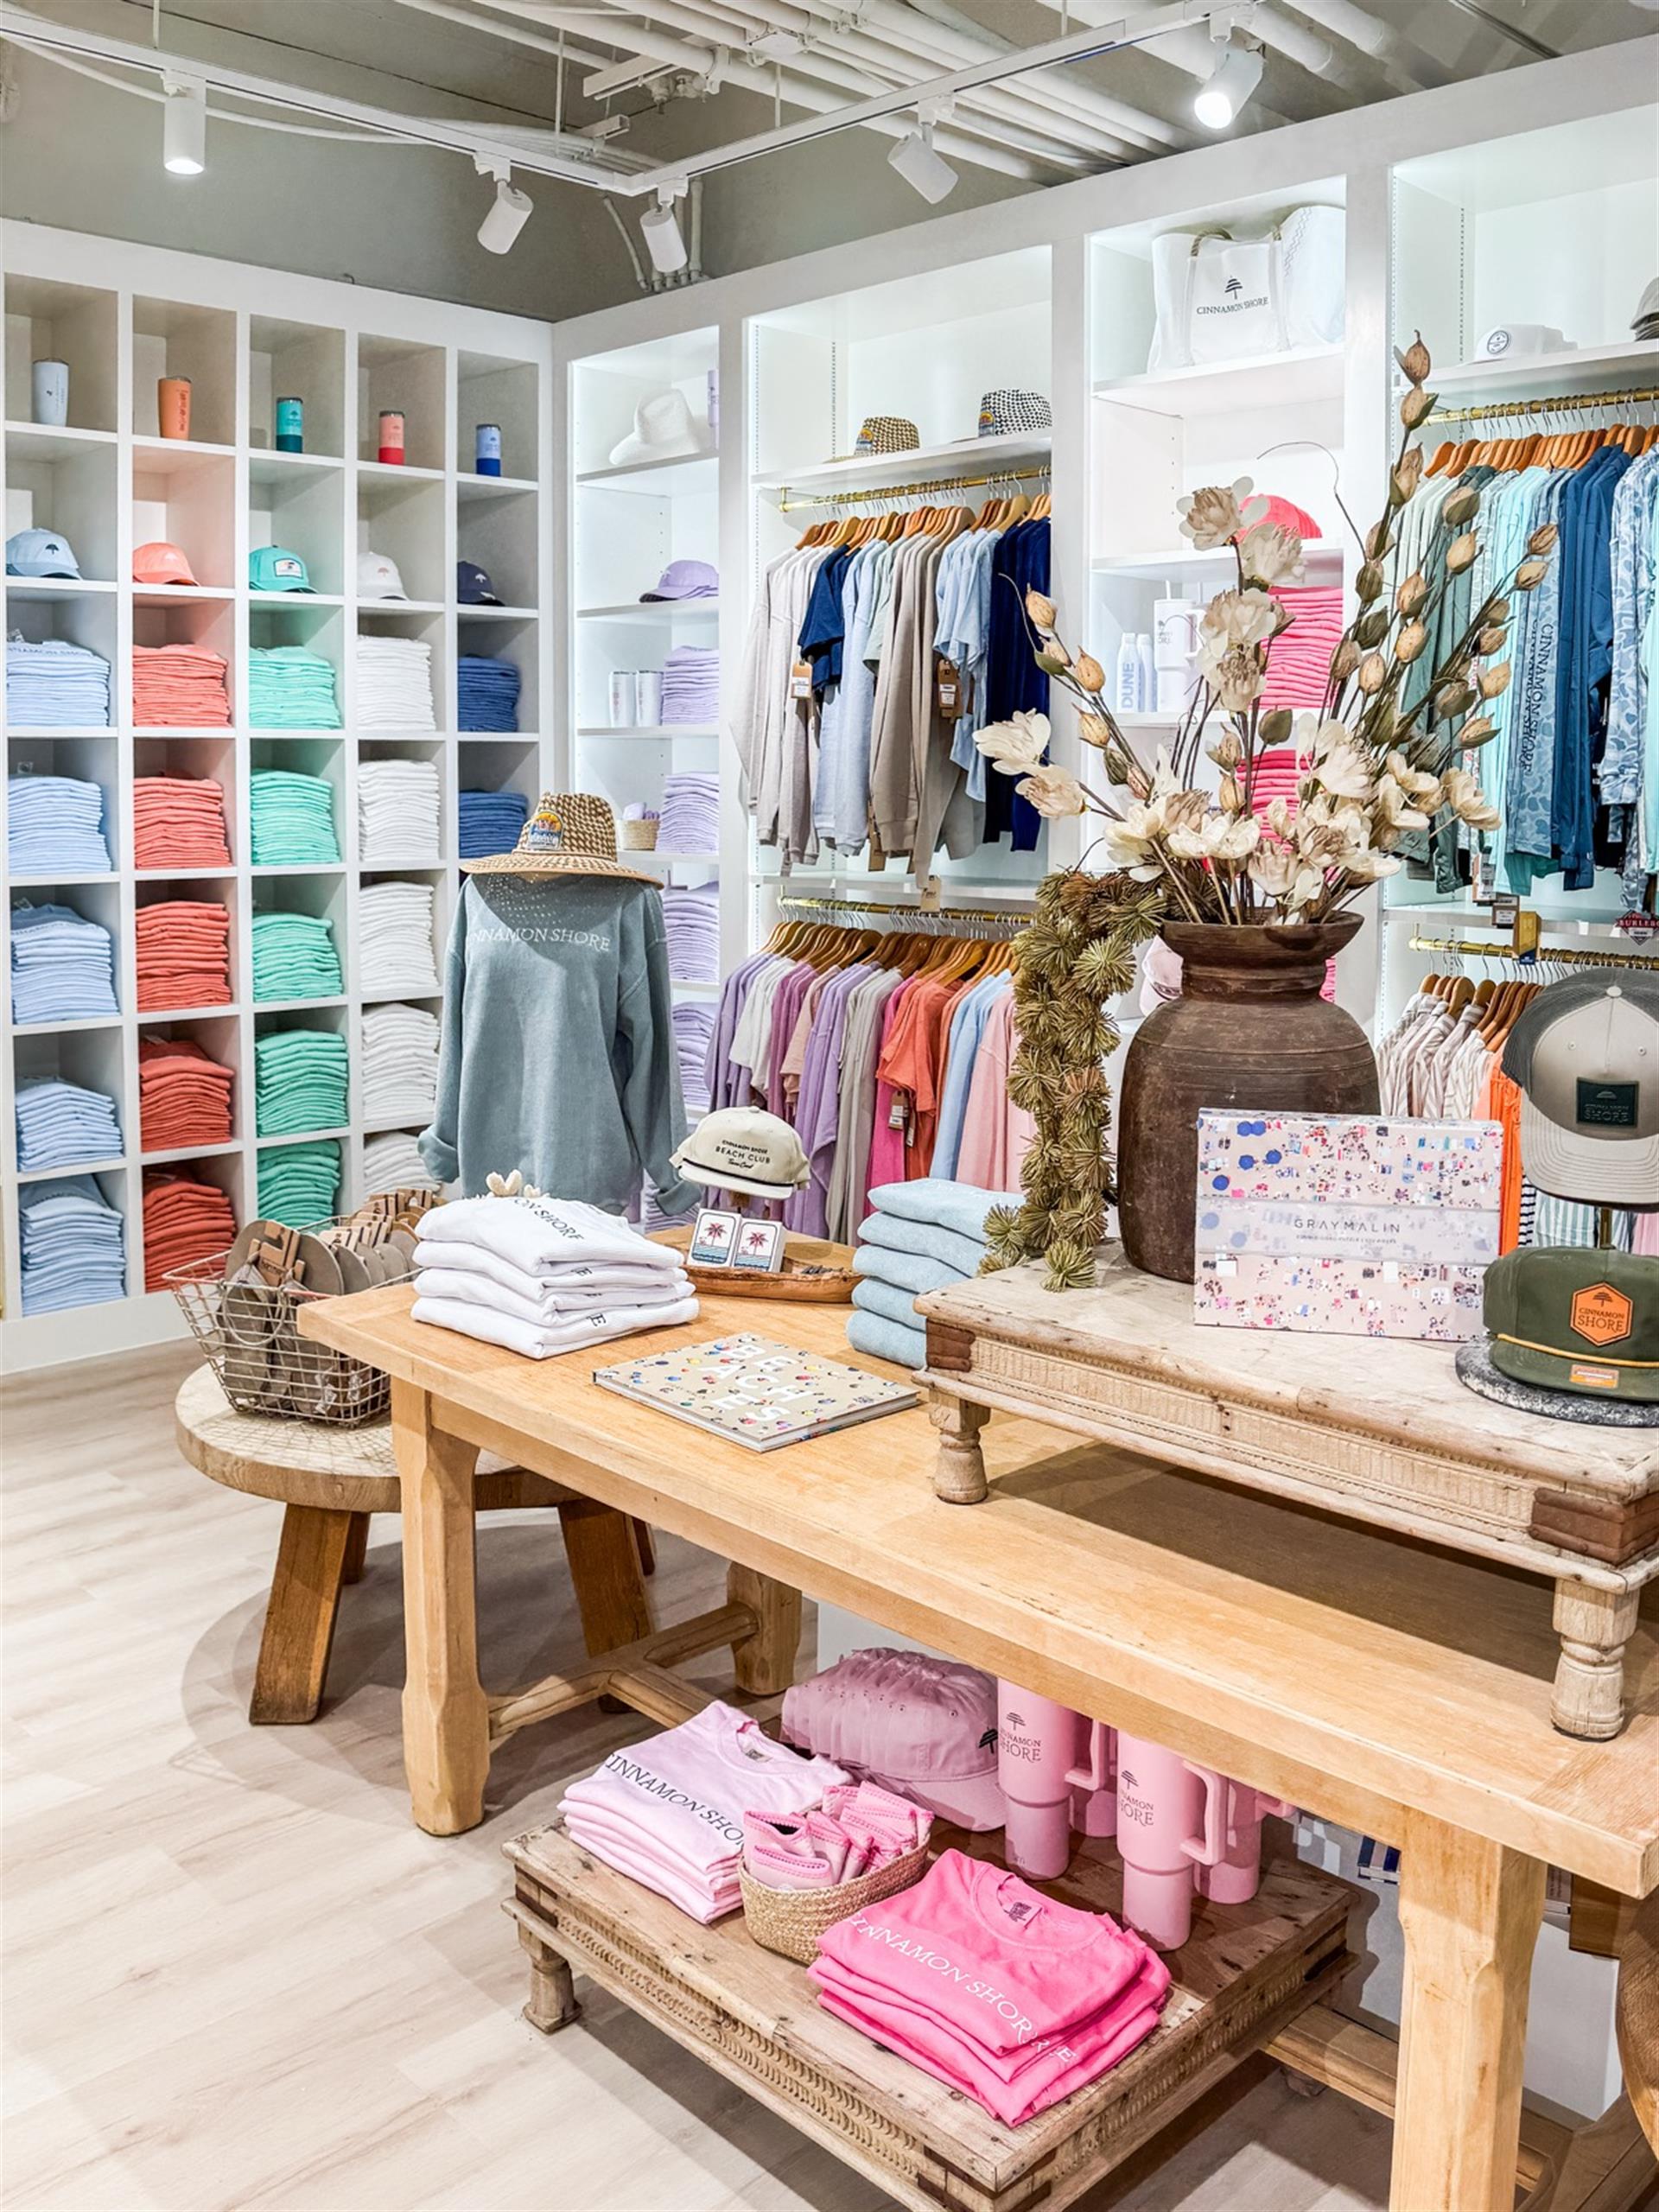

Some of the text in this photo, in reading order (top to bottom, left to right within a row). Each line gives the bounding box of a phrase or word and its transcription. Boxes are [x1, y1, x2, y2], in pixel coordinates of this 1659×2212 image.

[1197, 296, 1268, 315] CINNAMON SHORE
[1530, 624, 1554, 715] CINNAMON
[1122, 662, 1134, 709] DUNE
[550, 928, 610, 951] SHORE
[715, 1146, 745, 1160] BEACH
[747, 1154, 771, 1164] CLUB
[1578, 1315, 1624, 1333] SHORE
[1579, 1307, 1624, 1319] CINNAMON
[606, 1753, 745, 1846] INNAMON SHO
[850, 1911, 1037, 2044] INNAMON SHOR
